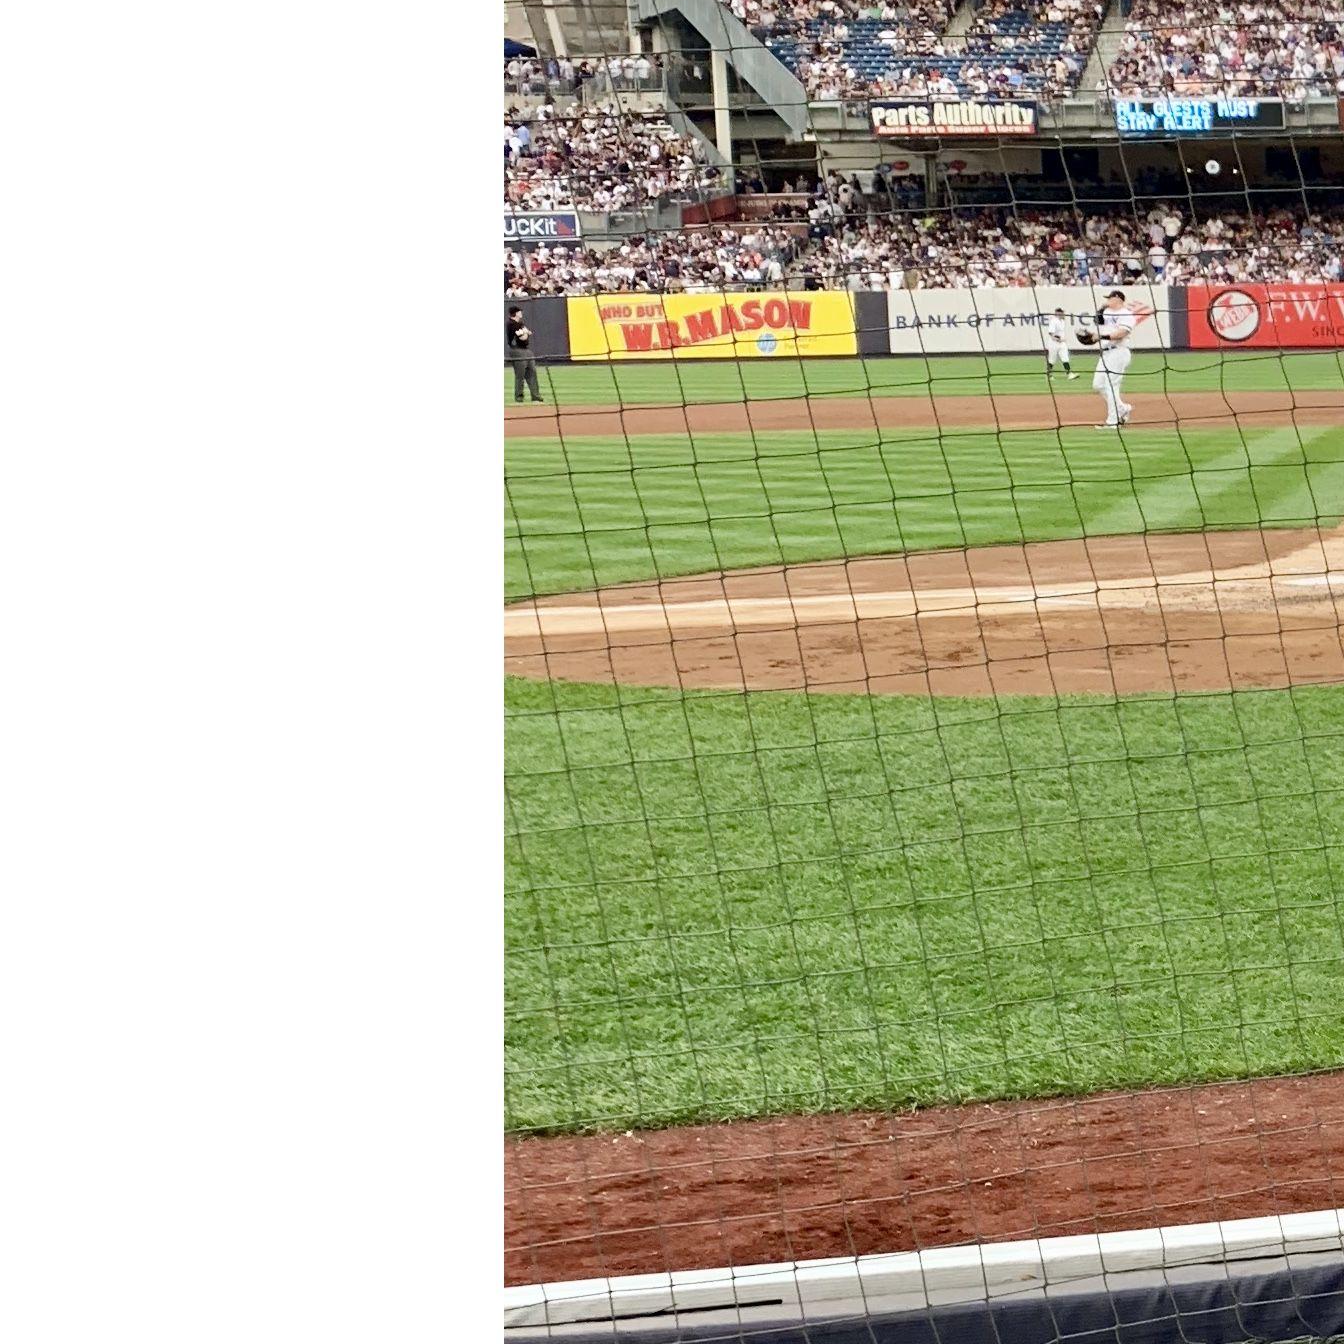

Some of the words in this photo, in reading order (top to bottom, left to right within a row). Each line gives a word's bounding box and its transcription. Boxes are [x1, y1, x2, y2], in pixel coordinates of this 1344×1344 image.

[871, 105, 930, 126] Parts
[933, 100, 1033, 127] Authority
[1116, 100, 1144, 117] ALL
[1217, 100, 1258, 117] MUST
[1117, 115, 1157, 130] STAY
[1163, 115, 1212, 130] ALERT
[600, 304, 632, 320] WHO
[636, 303, 664, 318] BUT
[1265, 290, 1326, 323] F.W.
[895, 313, 957, 330] BANK
[967, 312, 994, 329] OF
